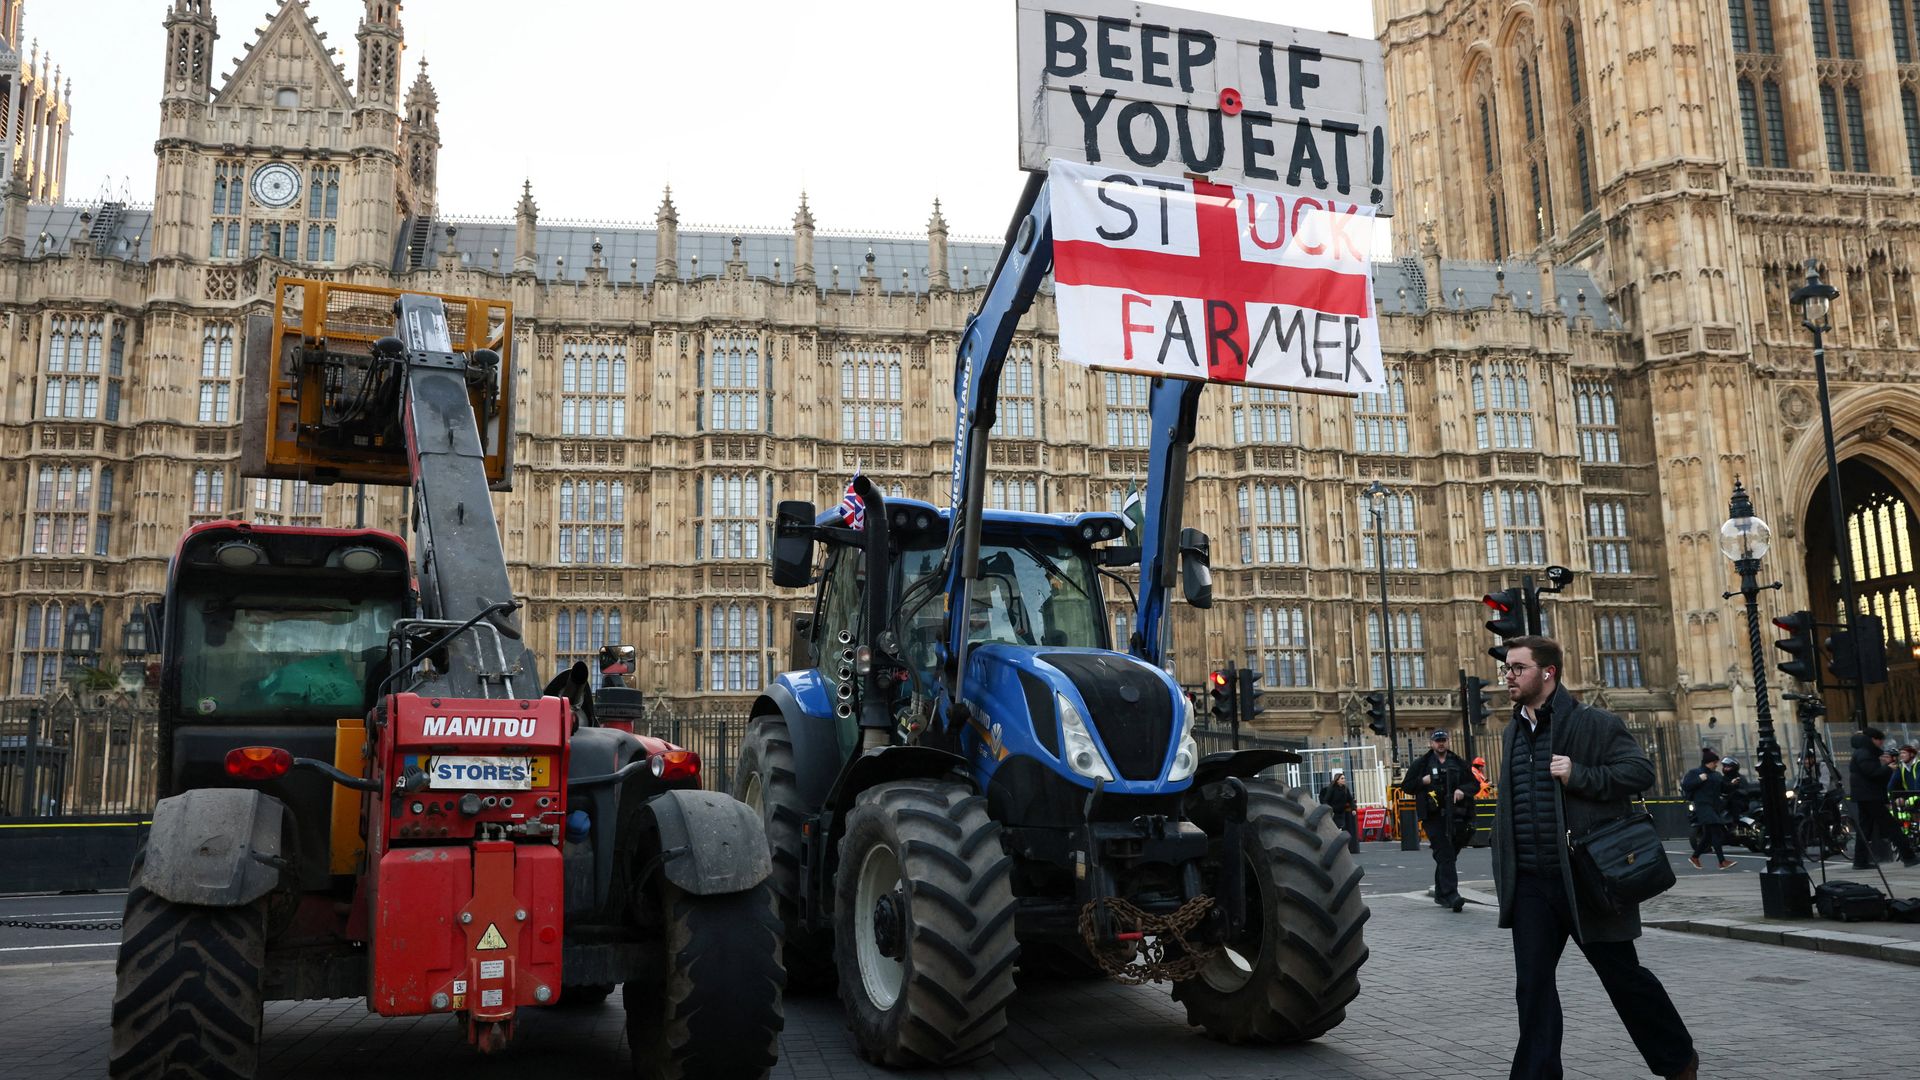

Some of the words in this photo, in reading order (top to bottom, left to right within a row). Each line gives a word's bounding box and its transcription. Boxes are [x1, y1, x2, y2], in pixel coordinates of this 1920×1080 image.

[1044, 12, 1217, 93] BEEP
[1259, 40, 1320, 110] IF
[1069, 85, 1225, 173] YOU
[1241, 110, 1384, 204] EAT!
[1121, 294, 1372, 383] FARMER
[952, 459, 962, 510] NEW
[957, 356, 971, 456] HOLLAND
[423, 717, 536, 737] MANITOU
[437, 764, 526, 781] STORES
